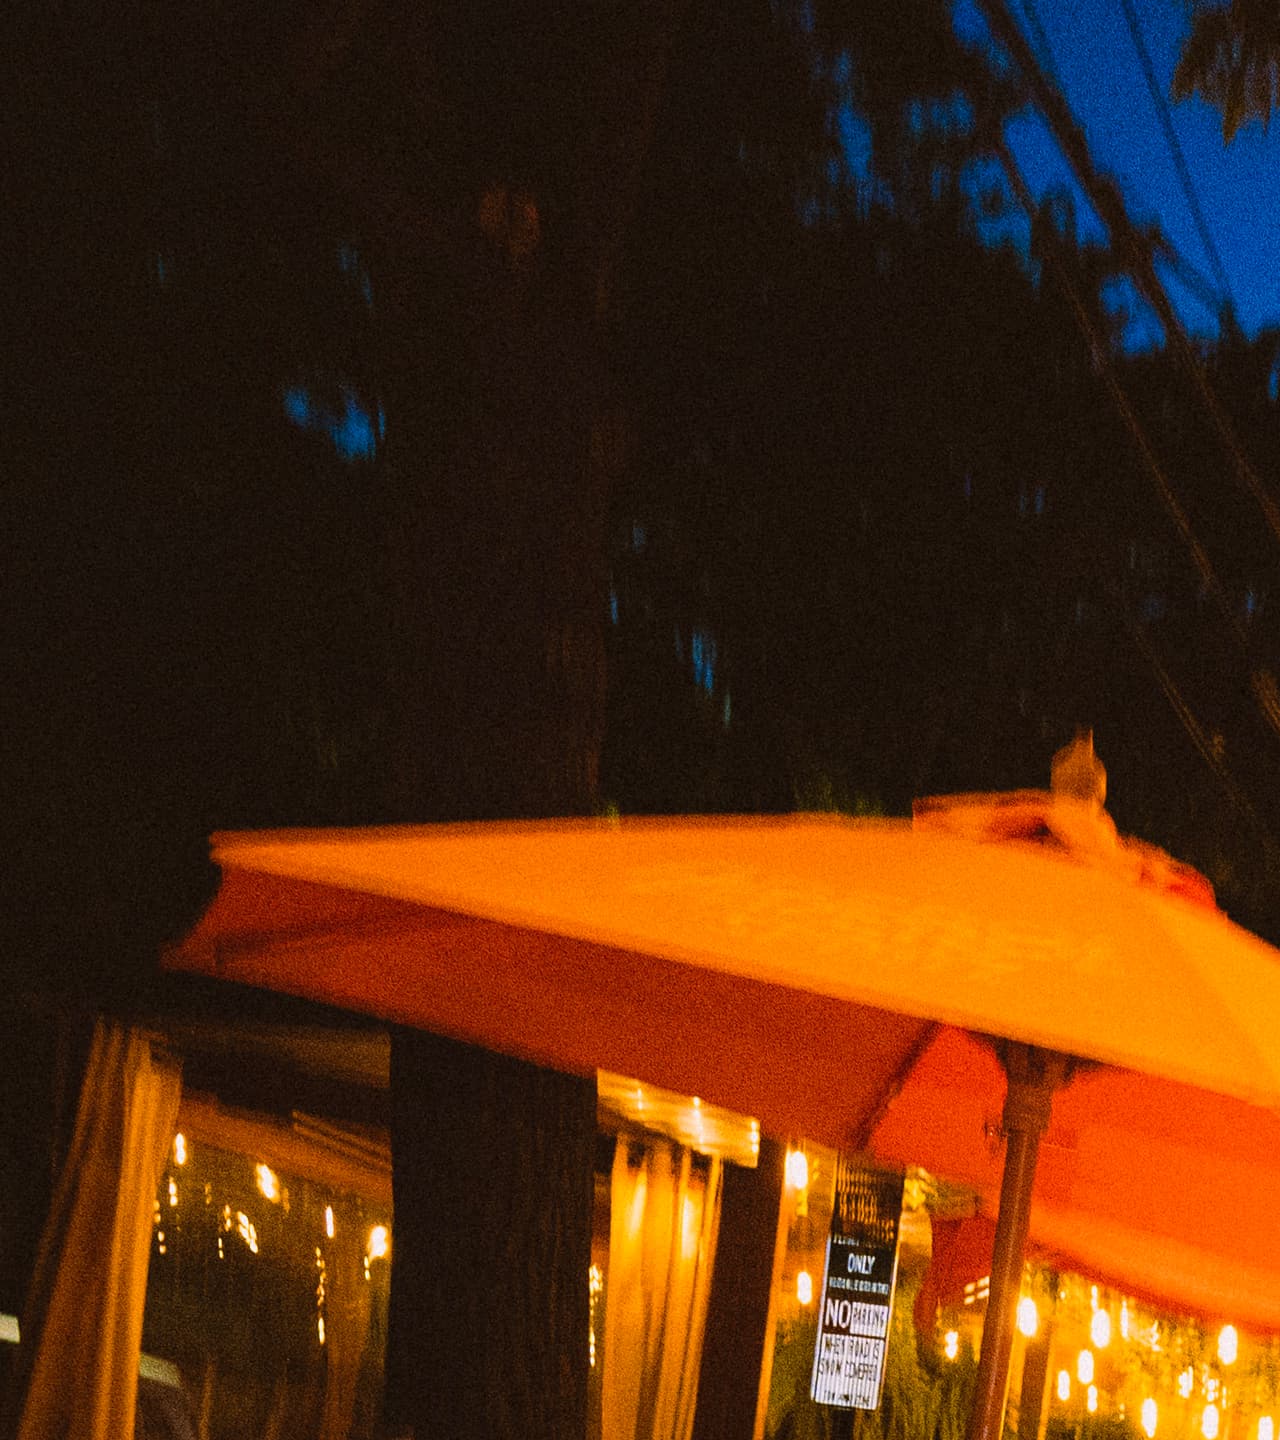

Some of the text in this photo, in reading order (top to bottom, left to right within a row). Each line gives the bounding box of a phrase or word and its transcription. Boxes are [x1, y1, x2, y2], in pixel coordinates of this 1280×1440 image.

[847, 1253, 876, 1275] ONLY
[825, 1297, 885, 1329] NO PARKING
[819, 1358, 841, 1376] SNOW
